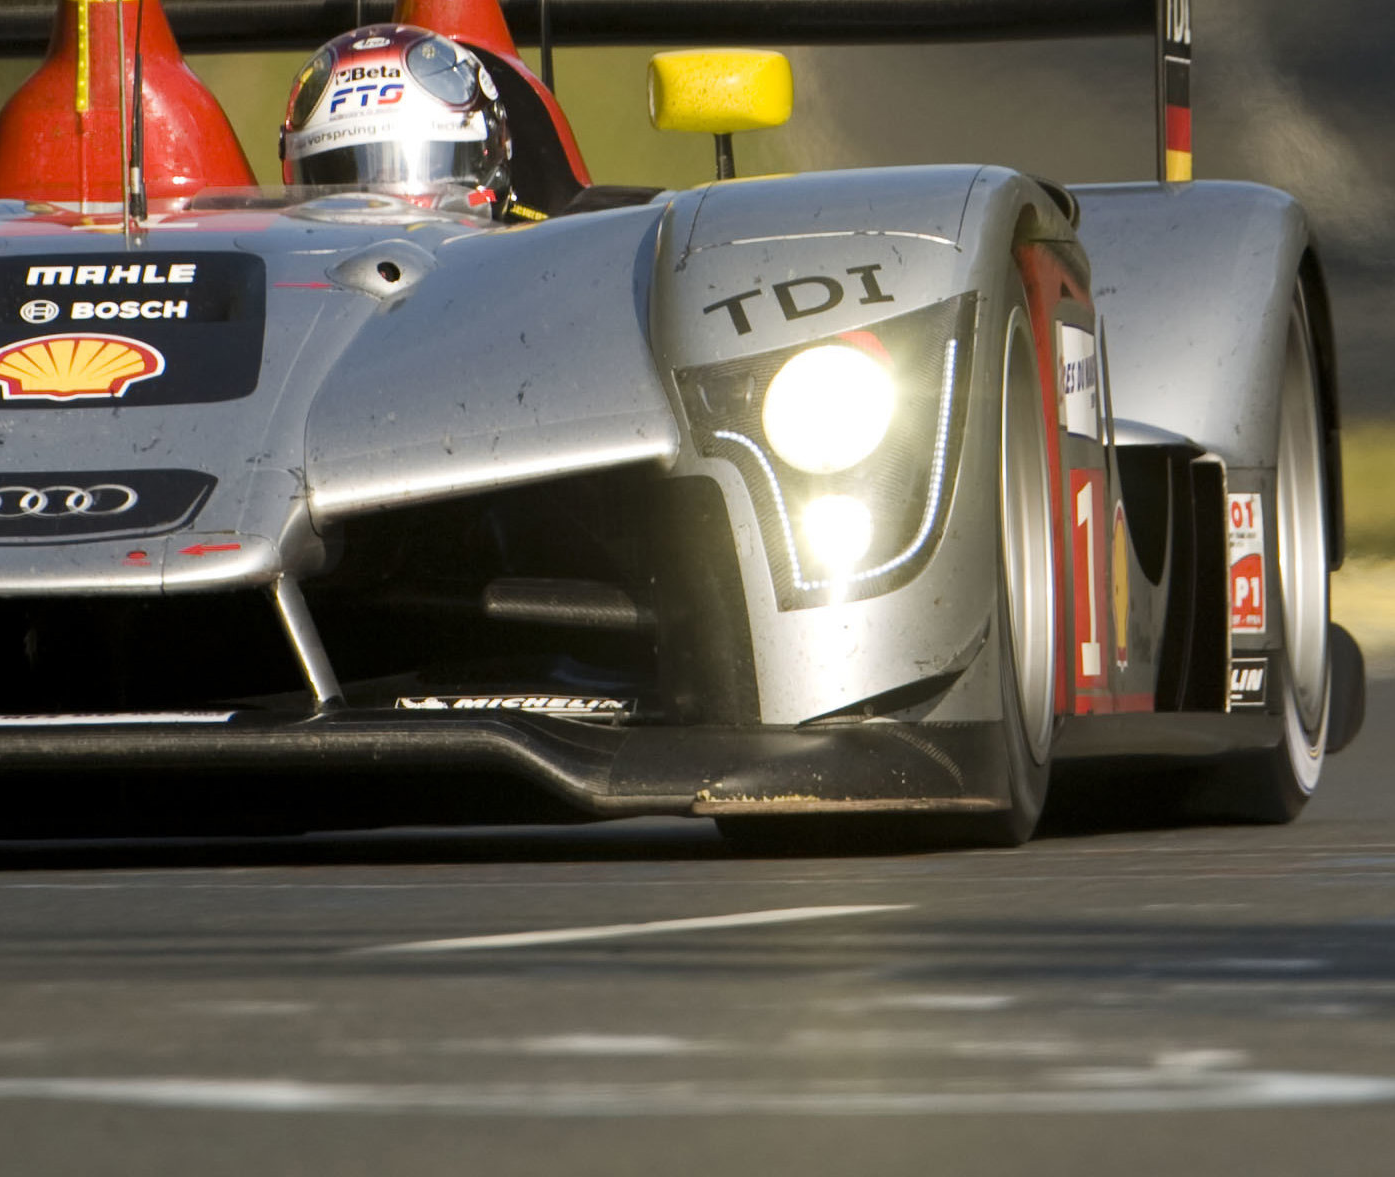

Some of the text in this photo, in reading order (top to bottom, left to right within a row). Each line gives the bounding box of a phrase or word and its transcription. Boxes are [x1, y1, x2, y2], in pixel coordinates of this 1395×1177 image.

[352, 66, 400, 81] Beta
[26, 264, 197, 286] MAHLE
[70, 300, 188, 320] BOSCH
[703, 264, 895, 336] TDI
[1076, 480, 1101, 676] 1
[1235, 577, 1260, 608] P1
[453, 696, 627, 710] MICHELIN
